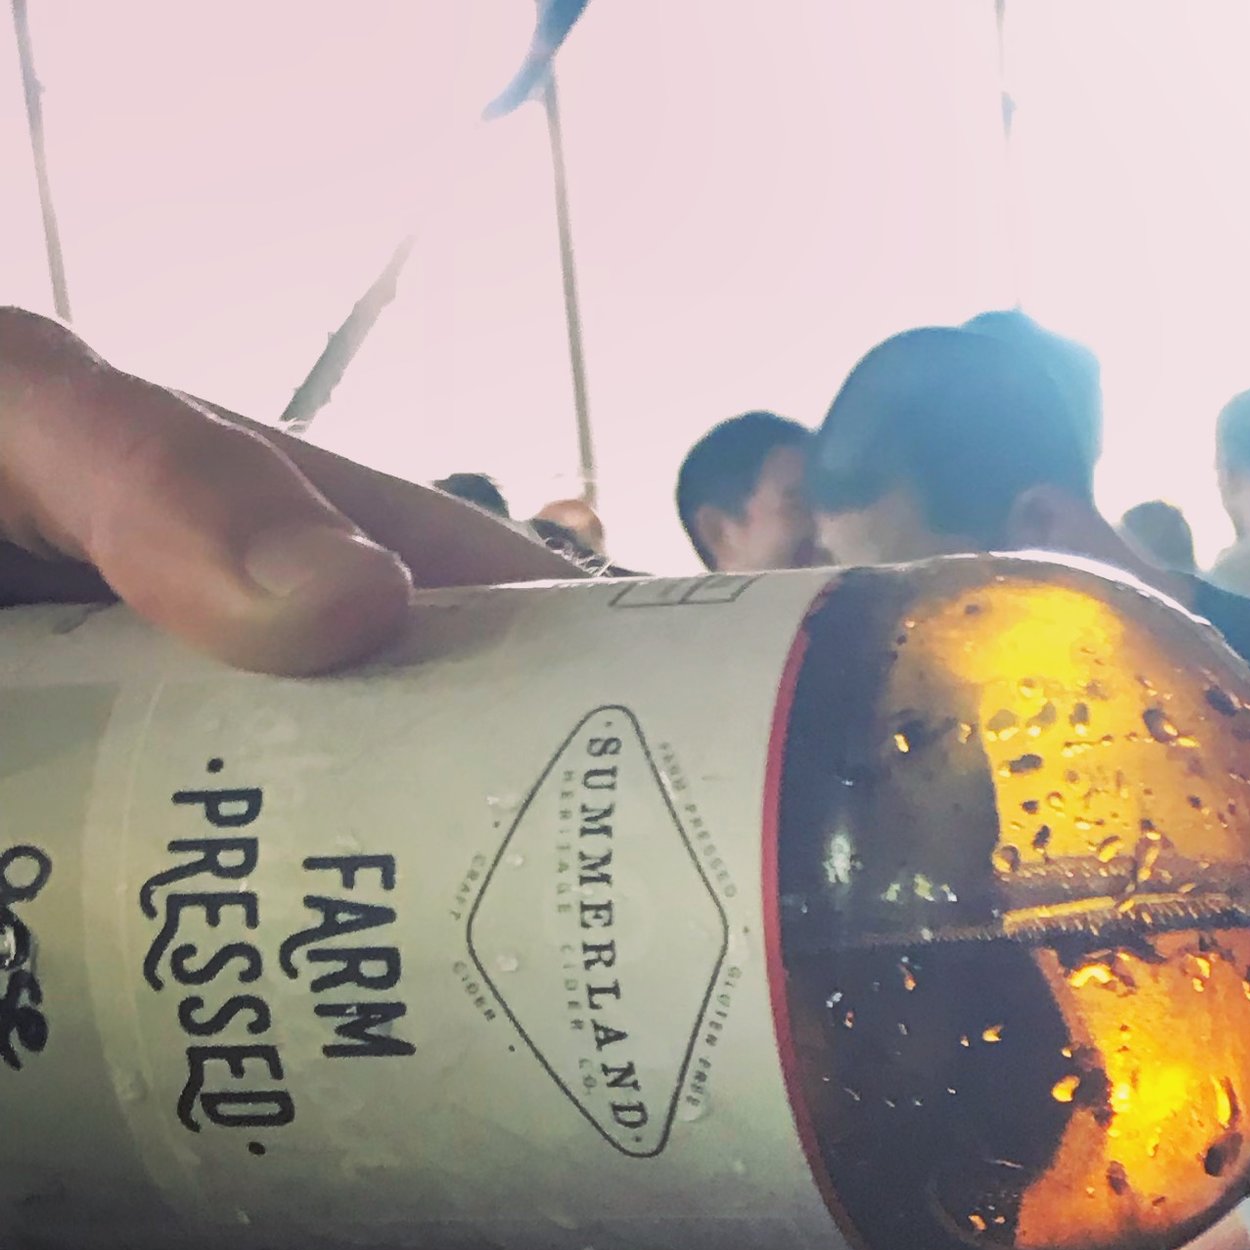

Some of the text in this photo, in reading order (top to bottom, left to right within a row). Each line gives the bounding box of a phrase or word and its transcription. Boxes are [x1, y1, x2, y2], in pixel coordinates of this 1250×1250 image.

[555, 769, 575, 914] HERITAGE
[578, 736, 649, 1129] SUMMERLAND
[139, 787, 296, 1134] PRESSED
[279, 853, 417, 1058] FARM
[560, 944, 584, 1031] CIDER
